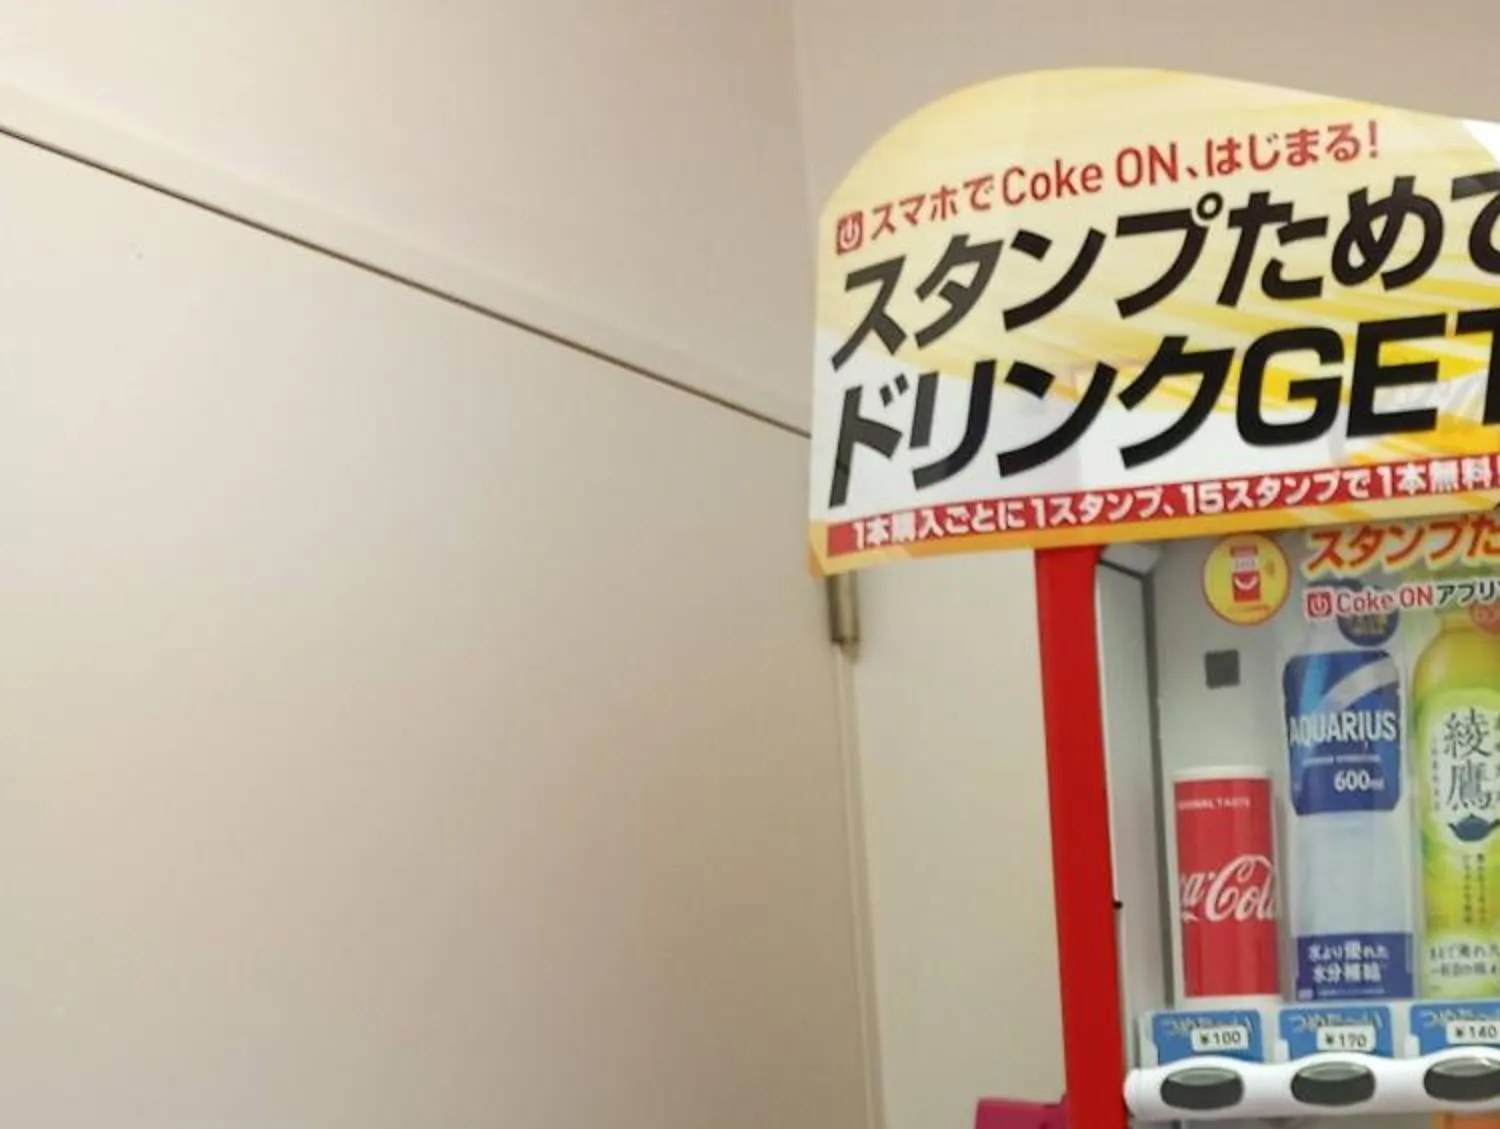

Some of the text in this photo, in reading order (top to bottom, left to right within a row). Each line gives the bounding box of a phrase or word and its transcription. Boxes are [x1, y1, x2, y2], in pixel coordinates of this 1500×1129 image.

[1289, 710, 1398, 745] AQUARIUS
[1443, 706, 1492, 811] 綾鷹
[1455, 1025, 1498, 1039] ¥140
